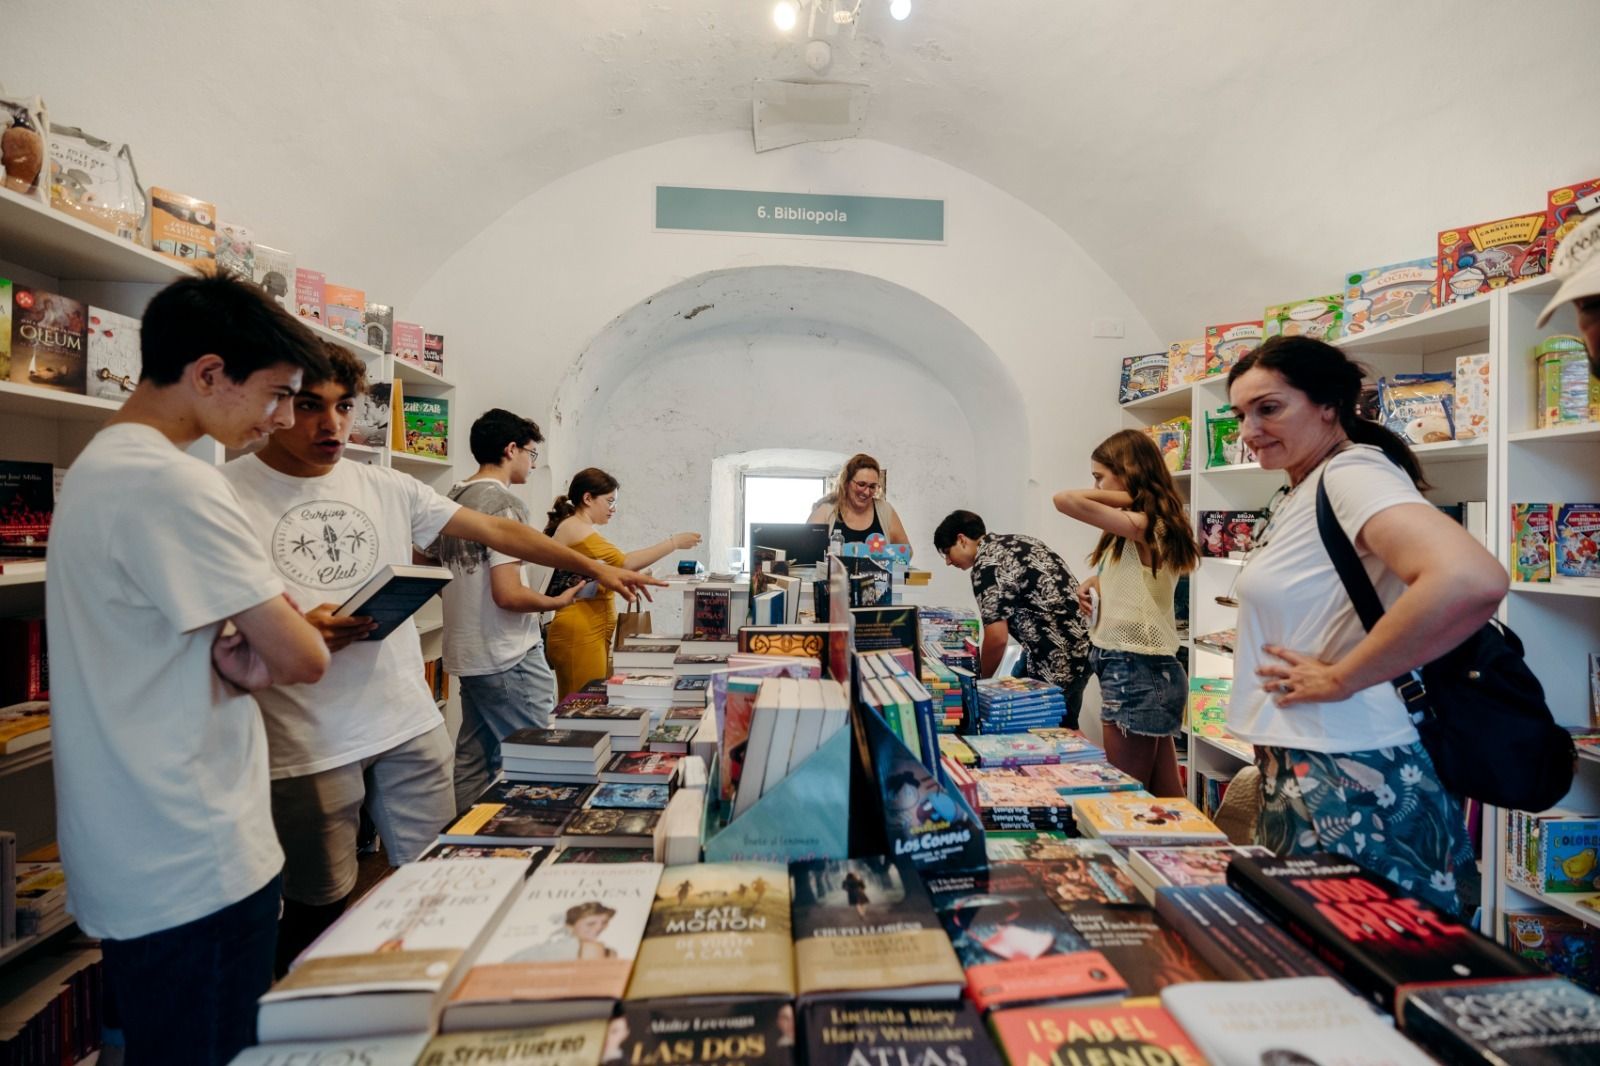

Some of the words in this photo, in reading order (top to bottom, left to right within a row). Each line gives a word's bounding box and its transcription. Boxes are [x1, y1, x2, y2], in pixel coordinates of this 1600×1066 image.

[756, 205, 771, 219] 6.
[774, 206, 848, 225] Bibliopola
[1479, 222, 1531, 237] CABALLEROS
[1485, 234, 1528, 245] DRAGONES
[1376, 271, 1423, 286] COCINAS
[20, 324, 81, 351] OLEUM
[300, 508, 348, 522] Surfing
[317, 561, 358, 584] Club
[895, 837, 920, 855] LOS
[920, 829, 971, 850] COMPAS
[1554, 834, 1600, 849] COLORE
[432, 864, 486, 878] LUIS
[398, 878, 496, 892] ZUECO
[577, 877, 603, 887] LA
[1290, 877, 1390, 902] TODO
[528, 887, 642, 900] BARONESA
[694, 906, 742, 920] KATE
[665, 917, 767, 933] MORTON
[700, 948, 744, 960] CASA
[830, 1007, 906, 1025] Lucinda
[909, 1006, 957, 1026] Riley
[822, 1026, 877, 1045] Harry
[880, 1025, 974, 1042] Whittaker
[1026, 1015, 1157, 1043] ISABEL
[454, 1033, 587, 1064] SEPULTURERO
[631, 1040, 695, 1065] LAS
[701, 1033, 766, 1062] DOS
[848, 1045, 969, 1066] ATLAS
[1026, 1044, 1194, 1066] ALLENDE
